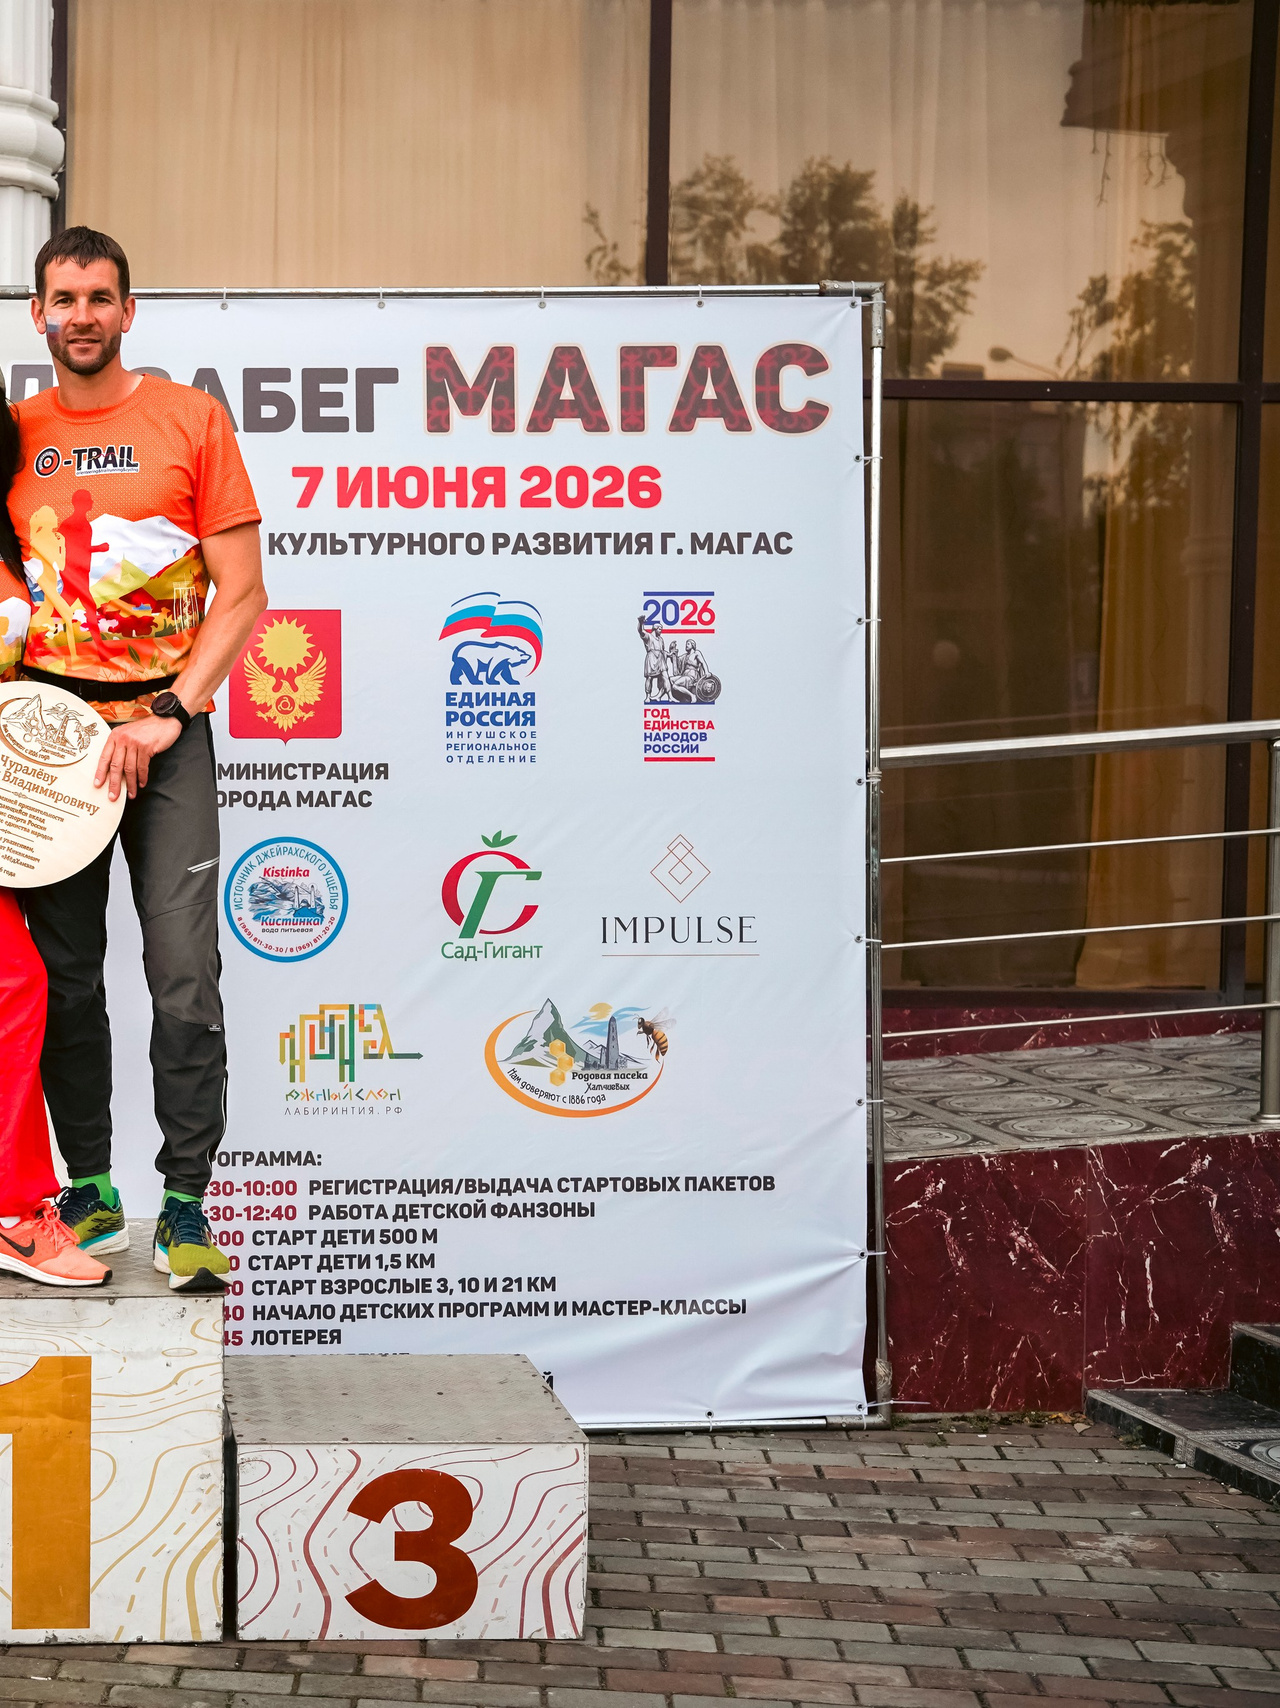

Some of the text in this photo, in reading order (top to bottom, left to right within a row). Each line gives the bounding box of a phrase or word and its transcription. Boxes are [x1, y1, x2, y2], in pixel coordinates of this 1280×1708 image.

[127, 366, 400, 434] АБЕГ
[424, 343, 832, 435] МАГАС
[291, 464, 663, 510] 7 ИЮНЯ 2026
[268, 531, 794, 557] КУЛЬТУРНОГО РАЗВИТИЯ Г. МАГАС
[642, 598, 717, 628] 2026
[445, 691, 536, 709] ЕДИНАЯ
[445, 710, 536, 727] РОССИЯ
[643, 708, 670, 720] ГОД
[446, 730, 537, 740] ИНГУШСКОЕ
[643, 720, 715, 732] ЕДИНСТВА
[446, 742, 537, 752] РЕГИОНАЛЬНОЕ
[643, 732, 708, 744] НАРОДОВ
[643, 743, 700, 754] РОССИИ
[446, 754, 537, 765] ОТДЕЛЕНИЕ
[0, 754, 59, 786] Чуралёву
[218, 762, 389, 783] МИНИСТРАЦИЯ
[2, 770, 101, 816] Владимировичу
[216, 790, 373, 811] ОРОДА МАГАС
[233, 845, 339, 911] ИСТОЧНИК ДЖЕЙРАХСКОГО УЩЕЛЬЯ
[263, 866, 310, 878] Kistinka
[261, 915, 320, 926] Кистинка
[601, 915, 758, 945] IMPULSE
[440, 939, 544, 962] Сад-Гигант
[507, 1067, 522, 1084] Нам
[519, 1081, 561, 1102] доверяют
[568, 1095, 586, 1105] 1886
[586, 1094, 607, 1105] года
[571, 1071, 648, 1082] Родовая пасека
[584, 1082, 631, 1094] Хамчиевых
[211, 1150, 323, 1167] ОГРАММА:
[204, 1174, 776, 1198] :30-10:00 РЕГИСТРАЦИЯ/ВЫДАЧА СТАРТОВЫХ ПАКЕТОВ
[204, 1199, 596, 1223] :30-12:40 РАБОТА ДЕТСКОЙ ФАНЗОНЫ
[251, 1230, 317, 1246] СТАРТ
[320, 1229, 375, 1248] ДЕТИ
[378, 1228, 418, 1245] 500
[422, 1228, 438, 1244] М
[247, 1255, 314, 1271] СТАРТ
[316, 1254, 371, 1273] ДЕТИ
[374, 1254, 402, 1272] 1,5
[405, 1253, 436, 1269] КМ
[251, 1279, 317, 1296] СТАРТ
[320, 1278, 433, 1295] ВЗРОСЛЫЕ
[436, 1278, 455, 1296] 3,
[458, 1277, 481, 1293] 10
[484, 1277, 499, 1293] И
[501, 1277, 524, 1293] 21
[526, 1276, 557, 1292] КМ
[252, 1304, 336, 1321] НАЧАЛО
[340, 1302, 435, 1323] ДЕТСКИХ
[438, 1300, 551, 1319] ПРОГРАММ
[554, 1301, 568, 1317] И
[571, 1298, 748, 1317] МАСТЕР-КЛАССЫ
[250, 1328, 342, 1346] ЛОТЕРЕЯ
[344, 1467, 482, 1631] 3
